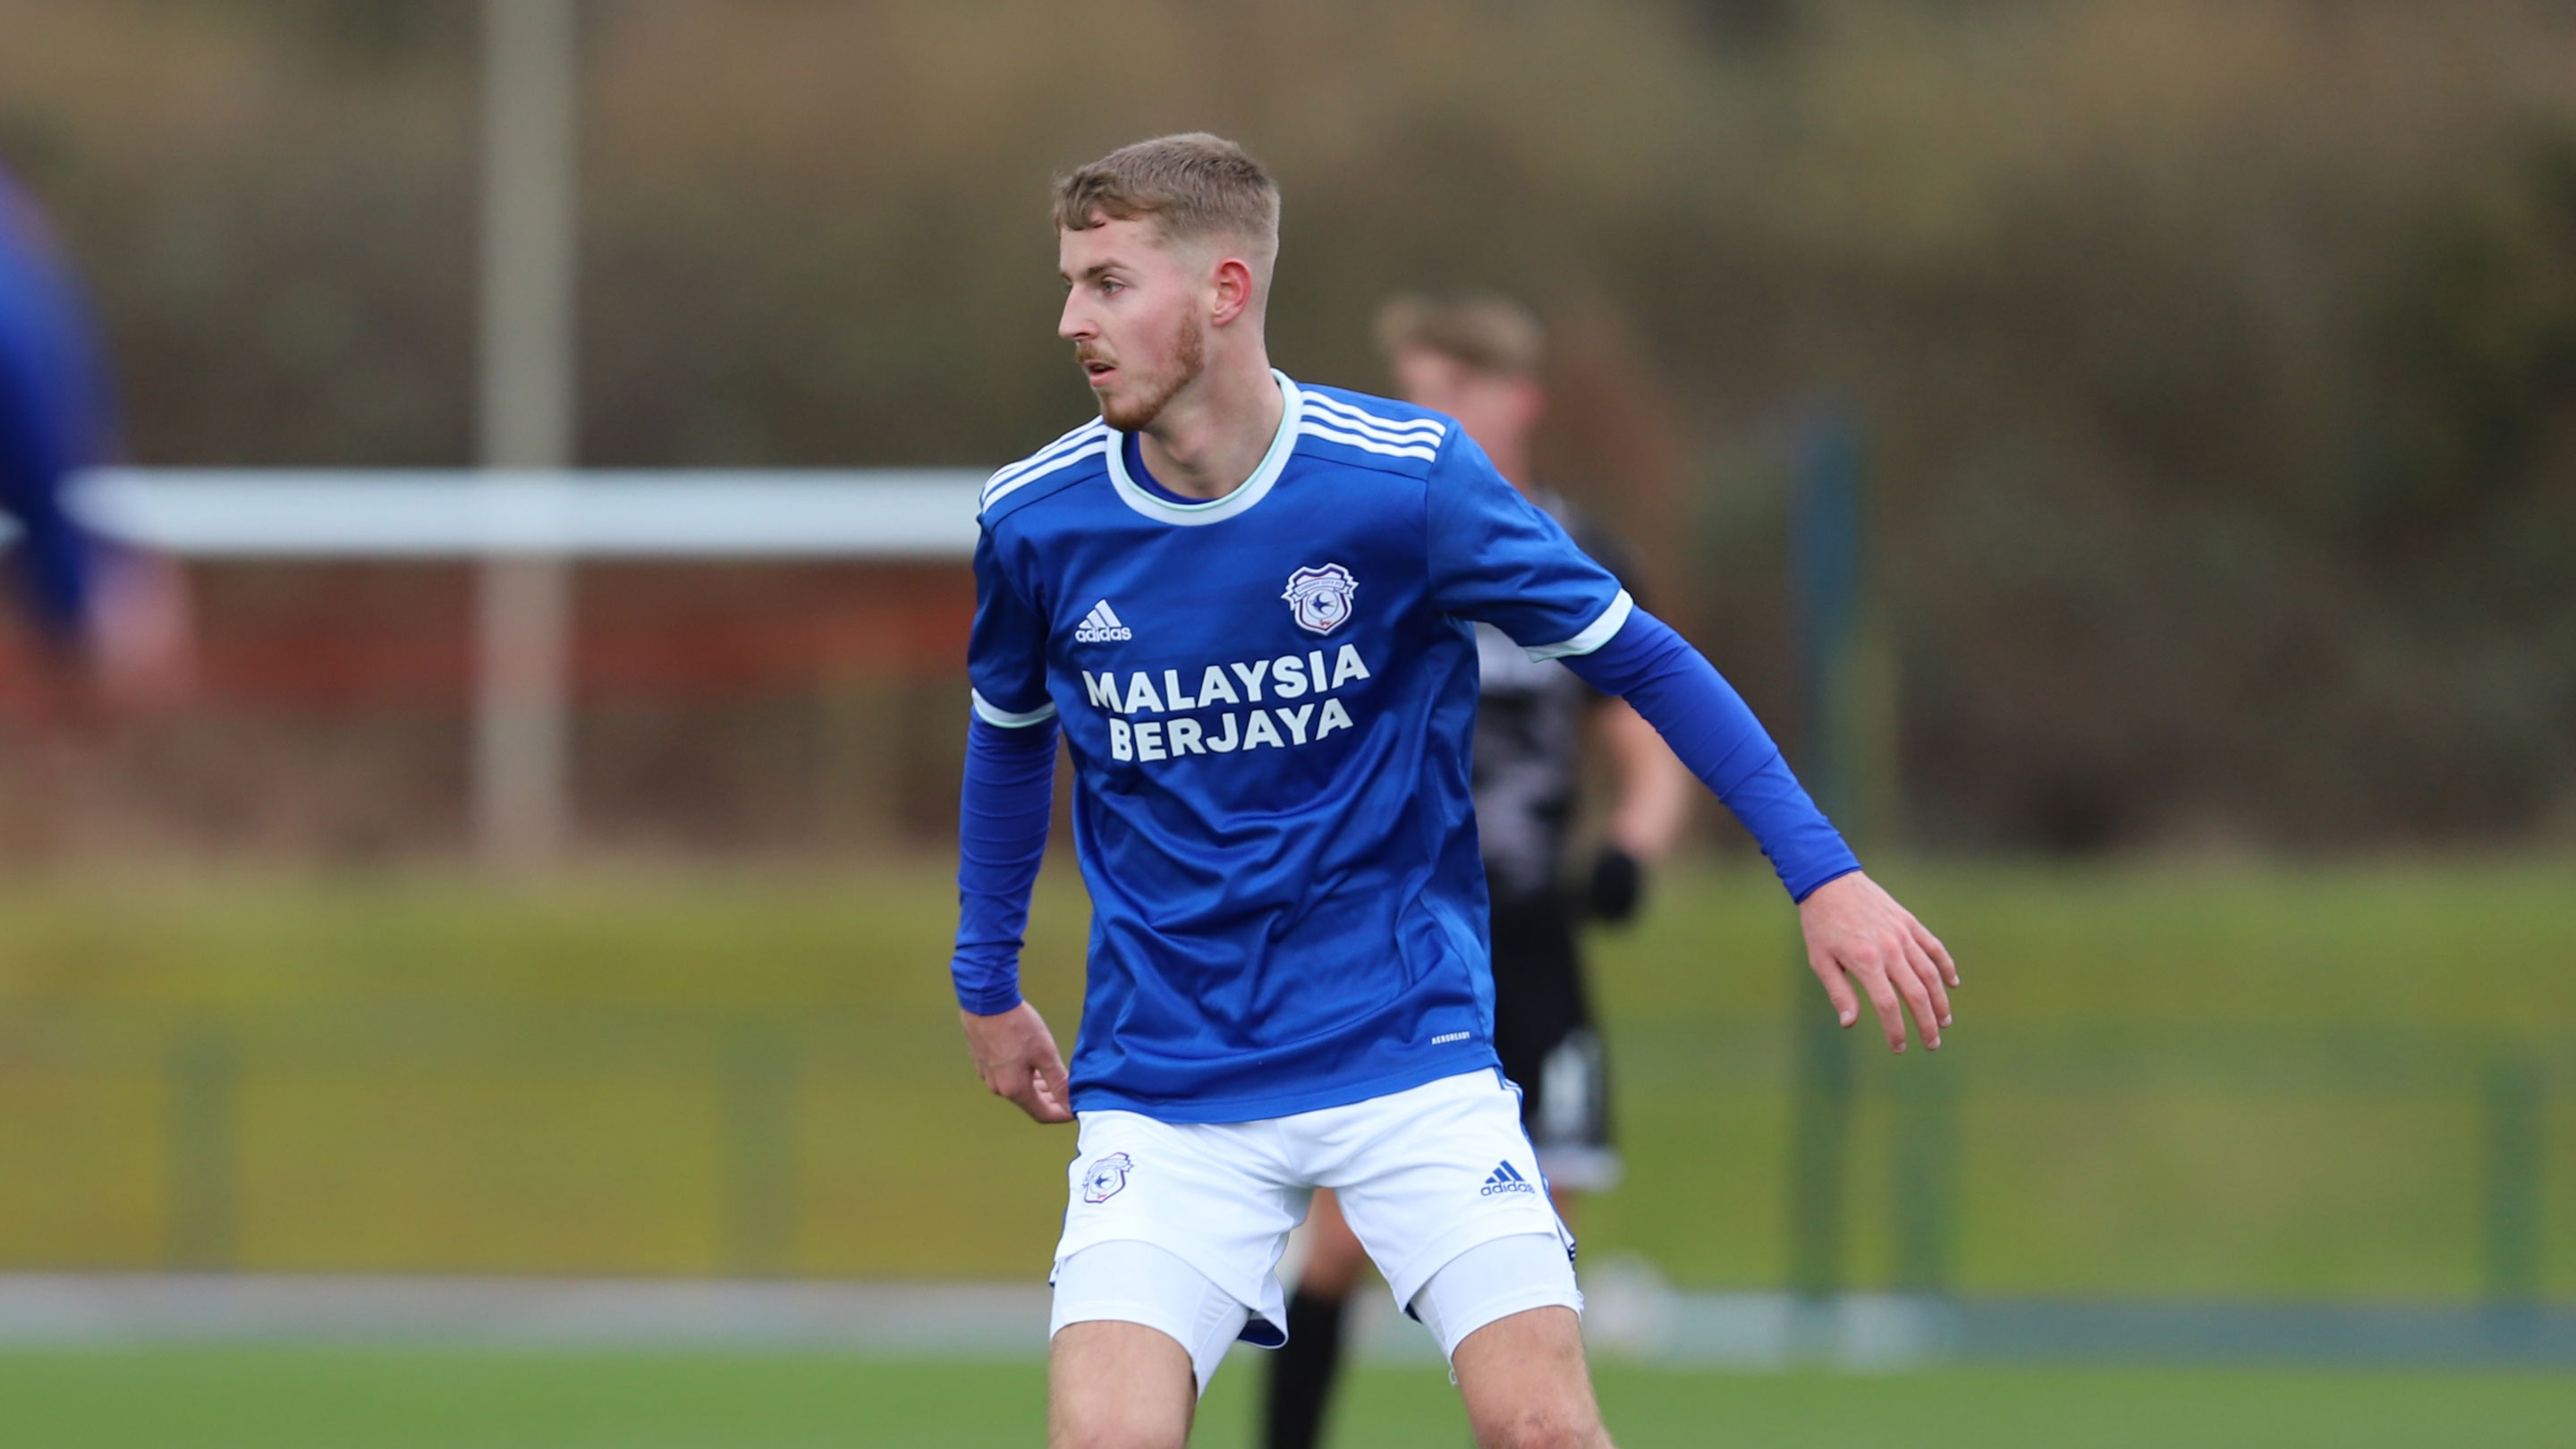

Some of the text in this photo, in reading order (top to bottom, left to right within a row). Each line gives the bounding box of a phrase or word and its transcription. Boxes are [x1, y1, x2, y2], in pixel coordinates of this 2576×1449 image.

[1075, 626, 1132, 643] adidas
[1081, 643, 1371, 714] MALAYSIA
[1109, 698, 1354, 763] BERJAYA
[1480, 1180, 1536, 1197] adidas
